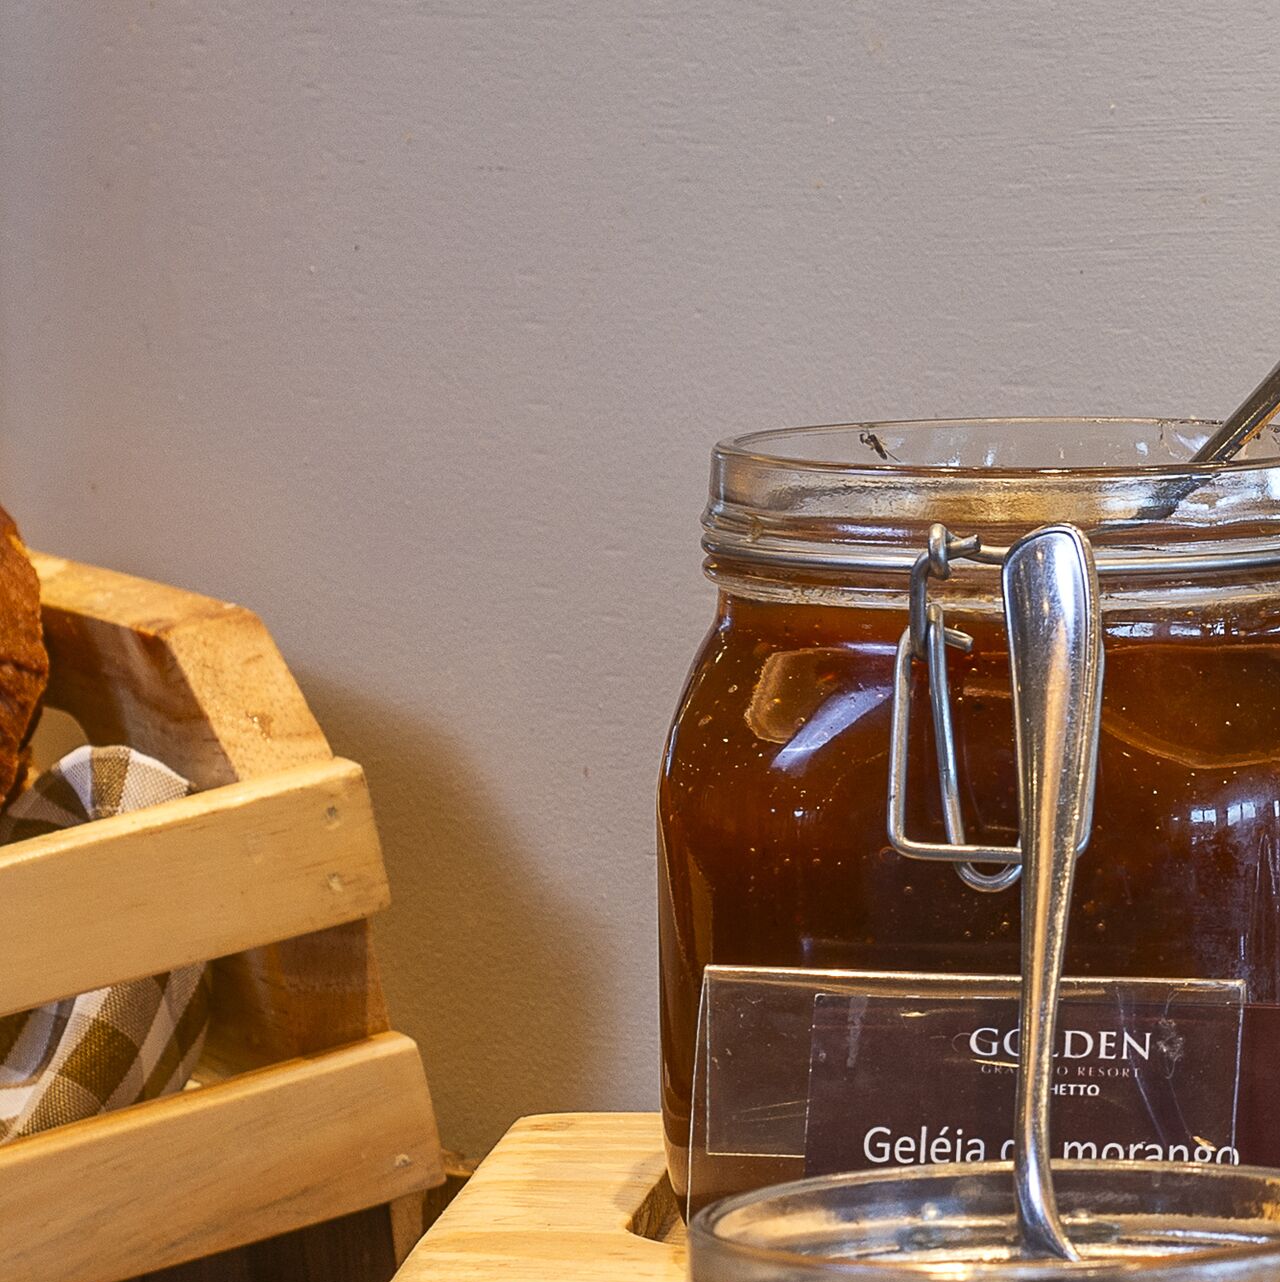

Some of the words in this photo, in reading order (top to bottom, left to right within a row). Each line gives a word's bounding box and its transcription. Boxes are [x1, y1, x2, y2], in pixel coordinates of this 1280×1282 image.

[969, 1027, 1152, 1061] GDEN
[980, 1064, 1070, 1077] GRAO
[1077, 1065, 1140, 1079] RESORT
[1050, 1083, 1100, 1097] HETTO
[863, 1125, 985, 1165] Geléia
